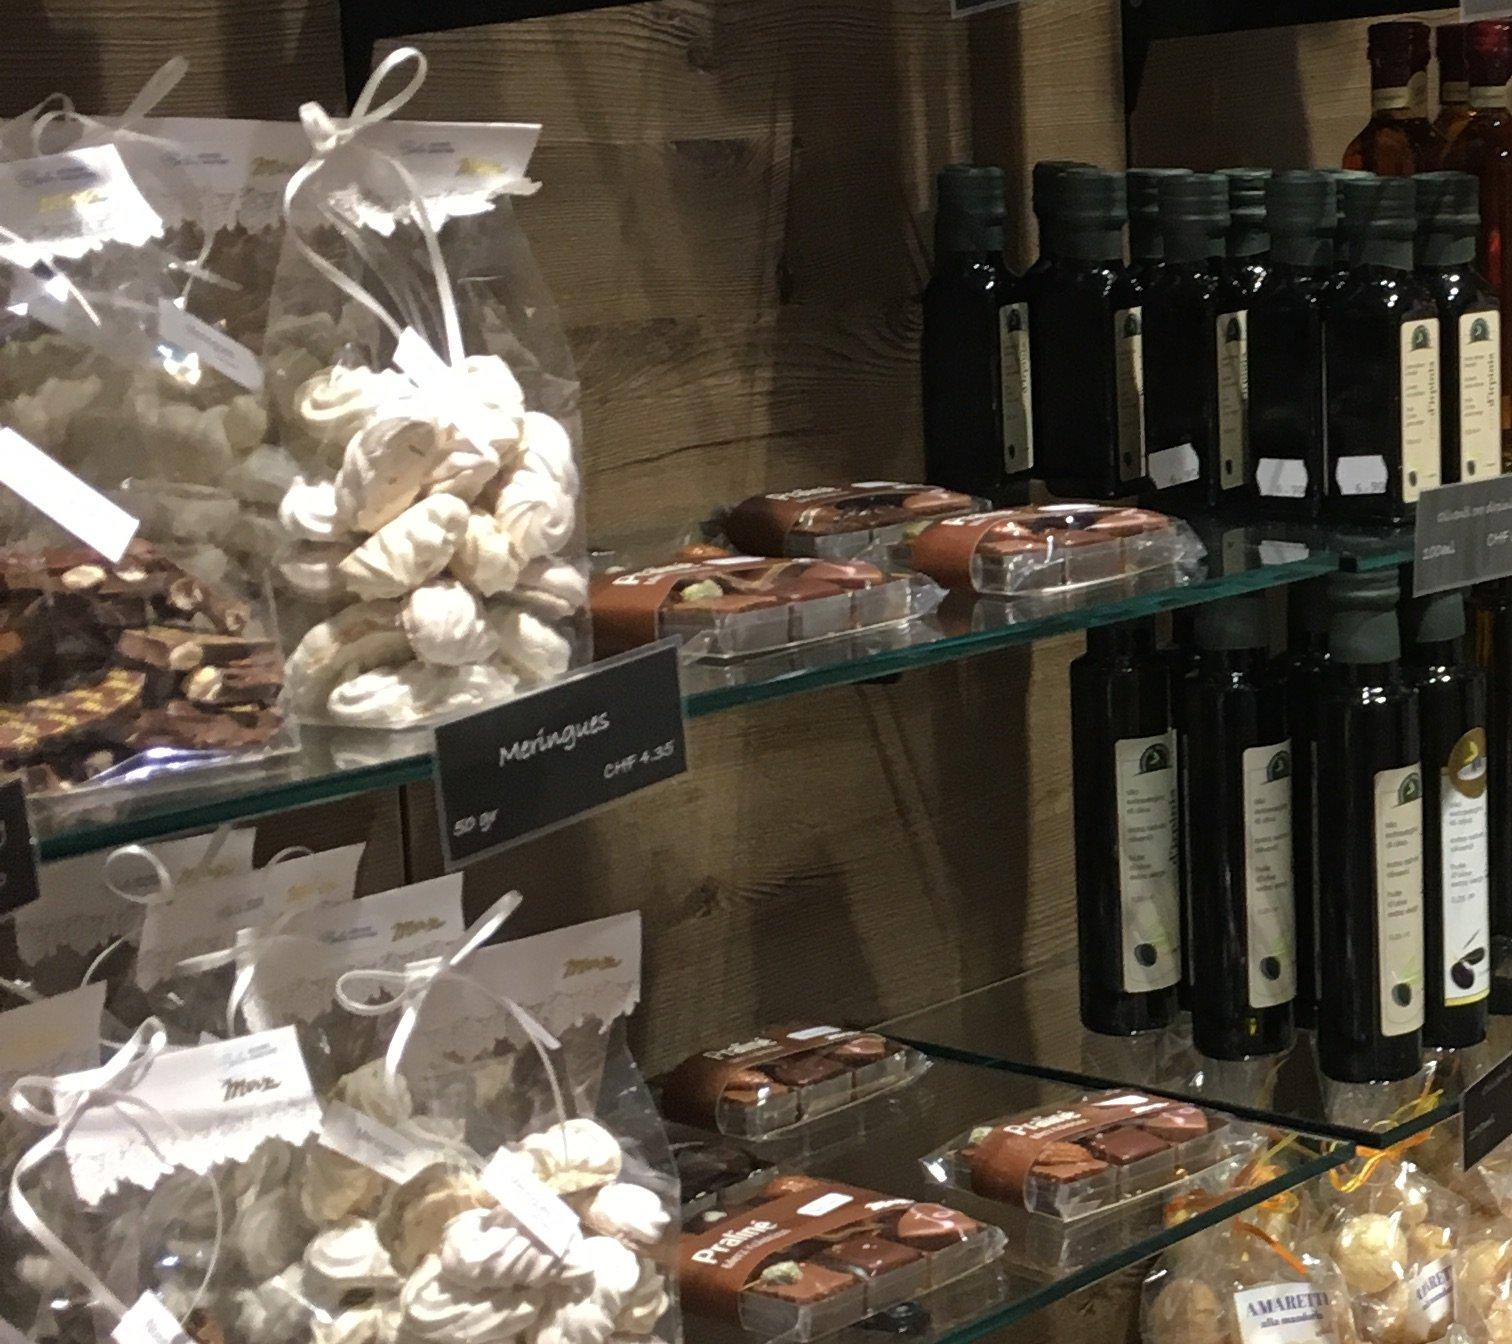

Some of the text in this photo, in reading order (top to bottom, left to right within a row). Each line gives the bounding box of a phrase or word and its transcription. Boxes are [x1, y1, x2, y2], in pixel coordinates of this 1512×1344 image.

[499, 711, 611, 767] Meringues
[603, 753, 636, 780] CHF
[690, 1219, 778, 1265] Praliné
[1246, 1291, 1330, 1317] AMARETTI
